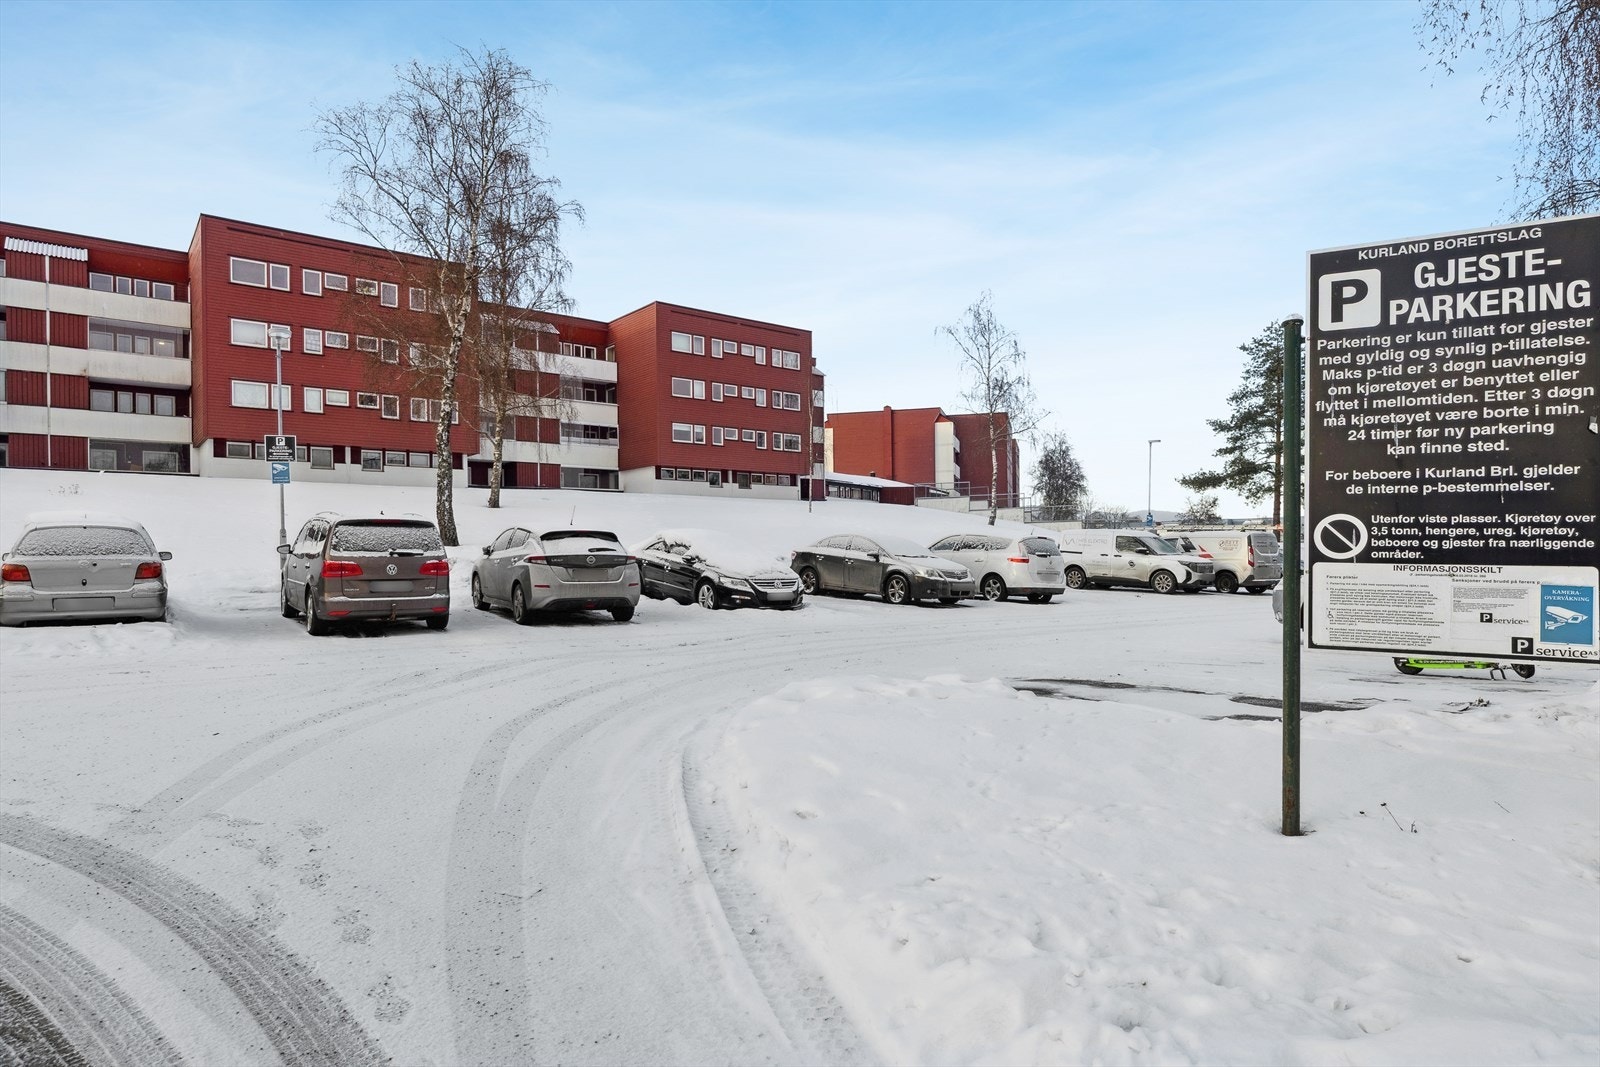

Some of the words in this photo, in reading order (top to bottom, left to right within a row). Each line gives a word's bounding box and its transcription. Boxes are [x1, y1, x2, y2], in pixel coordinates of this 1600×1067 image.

[1359, 242, 1430, 261] KURLAND
[1434, 227, 1542, 251] BORETTSLAG
[1414, 248, 1562, 288] GJESTE-
[1331, 279, 1368, 323] P
[1390, 280, 1591, 325] PARKERING
[1317, 333, 1391, 350] Parkering
[1396, 334, 1412, 344] er
[1417, 329, 1446, 342] kun
[1452, 324, 1495, 339] tillatt
[1500, 322, 1525, 334] for
[1530, 318, 1594, 337] gjester
[1319, 352, 1351, 366] med
[1356, 346, 1405, 366] gyldig
[1410, 348, 1430, 361] og
[1435, 342, 1486, 359] synlig
[1492, 334, 1590, 355] p-tillatelse.
[1323, 367, 1362, 381] Maks
[1367, 365, 1402, 381] p-tid
[1407, 363, 1423, 374] er
[1429, 362, 1437, 373] 3
[1443, 358, 1486, 376] døgn
[1492, 351, 1586, 369] uavhengig
[1328, 385, 1351, 396] om
[1357, 378, 1436, 396] kjøretøyet
[1441, 377, 1458, 388] er
[1463, 372, 1534, 390] benyttet
[1539, 368, 1580, 382] eller
[1315, 399, 1359, 414] flyttet
[1364, 398, 1368, 409] i
[1373, 393, 1478, 408] mellomtiden.
[1484, 389, 1525, 402] Etter
[1532, 388, 1541, 399] 3
[1547, 385, 1594, 402] døgn
[1323, 414, 1346, 427] må
[1351, 411, 1431, 428] kjøretøyet
[1436, 410, 1478, 421] være
[1483, 405, 1529, 418] borte
[1535, 404, 1539, 416] i
[1546, 403, 1585, 416] min.
[1348, 429, 1366, 441] 24
[1371, 427, 1410, 440] timer
[1416, 426, 1439, 438] før
[1445, 425, 1465, 440] ny
[1470, 422, 1554, 438] parkering
[1387, 443, 1415, 455] kan
[1421, 441, 1463, 454] finne
[1467, 440, 1509, 452] sted.
[1326, 470, 1349, 481] For
[1353, 468, 1411, 480] beboere
[1416, 468, 1420, 479] i
[1425, 467, 1486, 478] Kurland
[1490, 465, 1518, 477] Brl.
[1523, 464, 1580, 479] gjelder
[1346, 484, 1363, 495] de
[1368, 483, 1418, 494] interne
[1423, 480, 1554, 496] p-bestemmelser.
[1371, 515, 1415, 524] Utenfor
[1418, 514, 1448, 523] viste
[1452, 514, 1501, 526] plasser.
[1506, 513, 1561, 525] Kjøretøy
[1566, 514, 1596, 522] over
[1371, 527, 1388, 536] 3,5
[1391, 526, 1422, 537] tonn,
[1426, 526, 1479, 538] hengere,
[1484, 526, 1515, 538] ureg.
[1520, 525, 1579, 537] kjøretøy,
[1371, 538, 1419, 548] beboere
[1423, 539, 1438, 550] og
[1442, 538, 1485, 550] gjester
[1489, 538, 1506, 548] fra
[1510, 538, 1594, 551] nærliggende
[1371, 550, 1424, 559] områder.
[1393, 564, 1503, 574] INFORMASJONSSKILT
[1517, 640, 1528, 652] P
